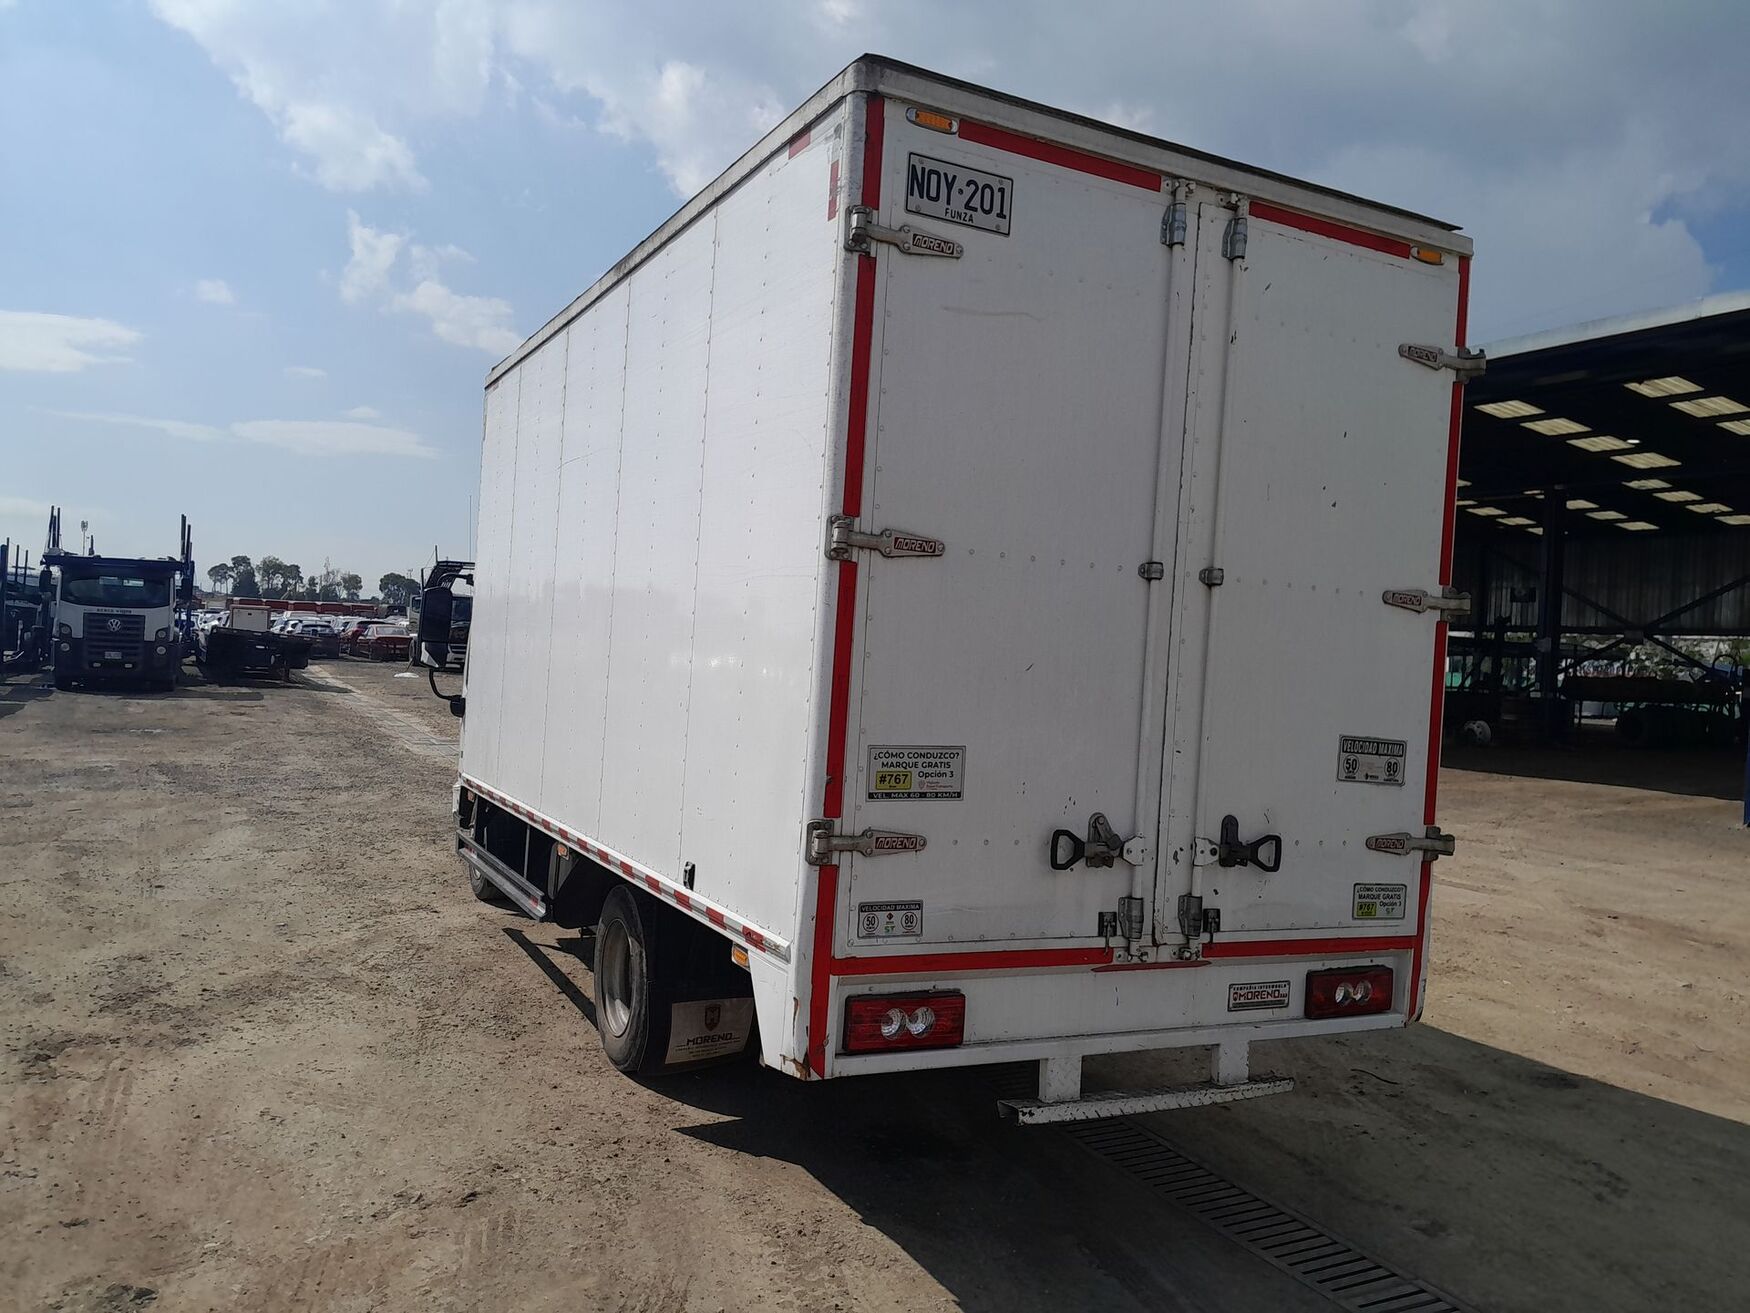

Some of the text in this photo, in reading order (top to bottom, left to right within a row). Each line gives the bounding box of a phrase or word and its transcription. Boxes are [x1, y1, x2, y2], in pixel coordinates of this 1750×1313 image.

[944, 207, 974, 223] FUNZA
[913, 235, 955, 254] MORENO
[895, 538, 935, 552] MORENO
[1343, 740, 1378, 755] VELOCIDAD
[906, 751, 960, 761] CONDUZCO?
[881, 761, 951, 770] MARQUE GRATIS
[1345, 758, 1398, 774] 50 80
[878, 773, 909, 785] #767
[917, 770, 955, 779] Opción 3
[876, 837, 916, 849] MORENO
[861, 904, 896, 912] VELOCIDAD
[865, 914, 914, 927] 50 80
[1238, 989, 1280, 1001] MORENO
[687, 1032, 733, 1046] MORENO
